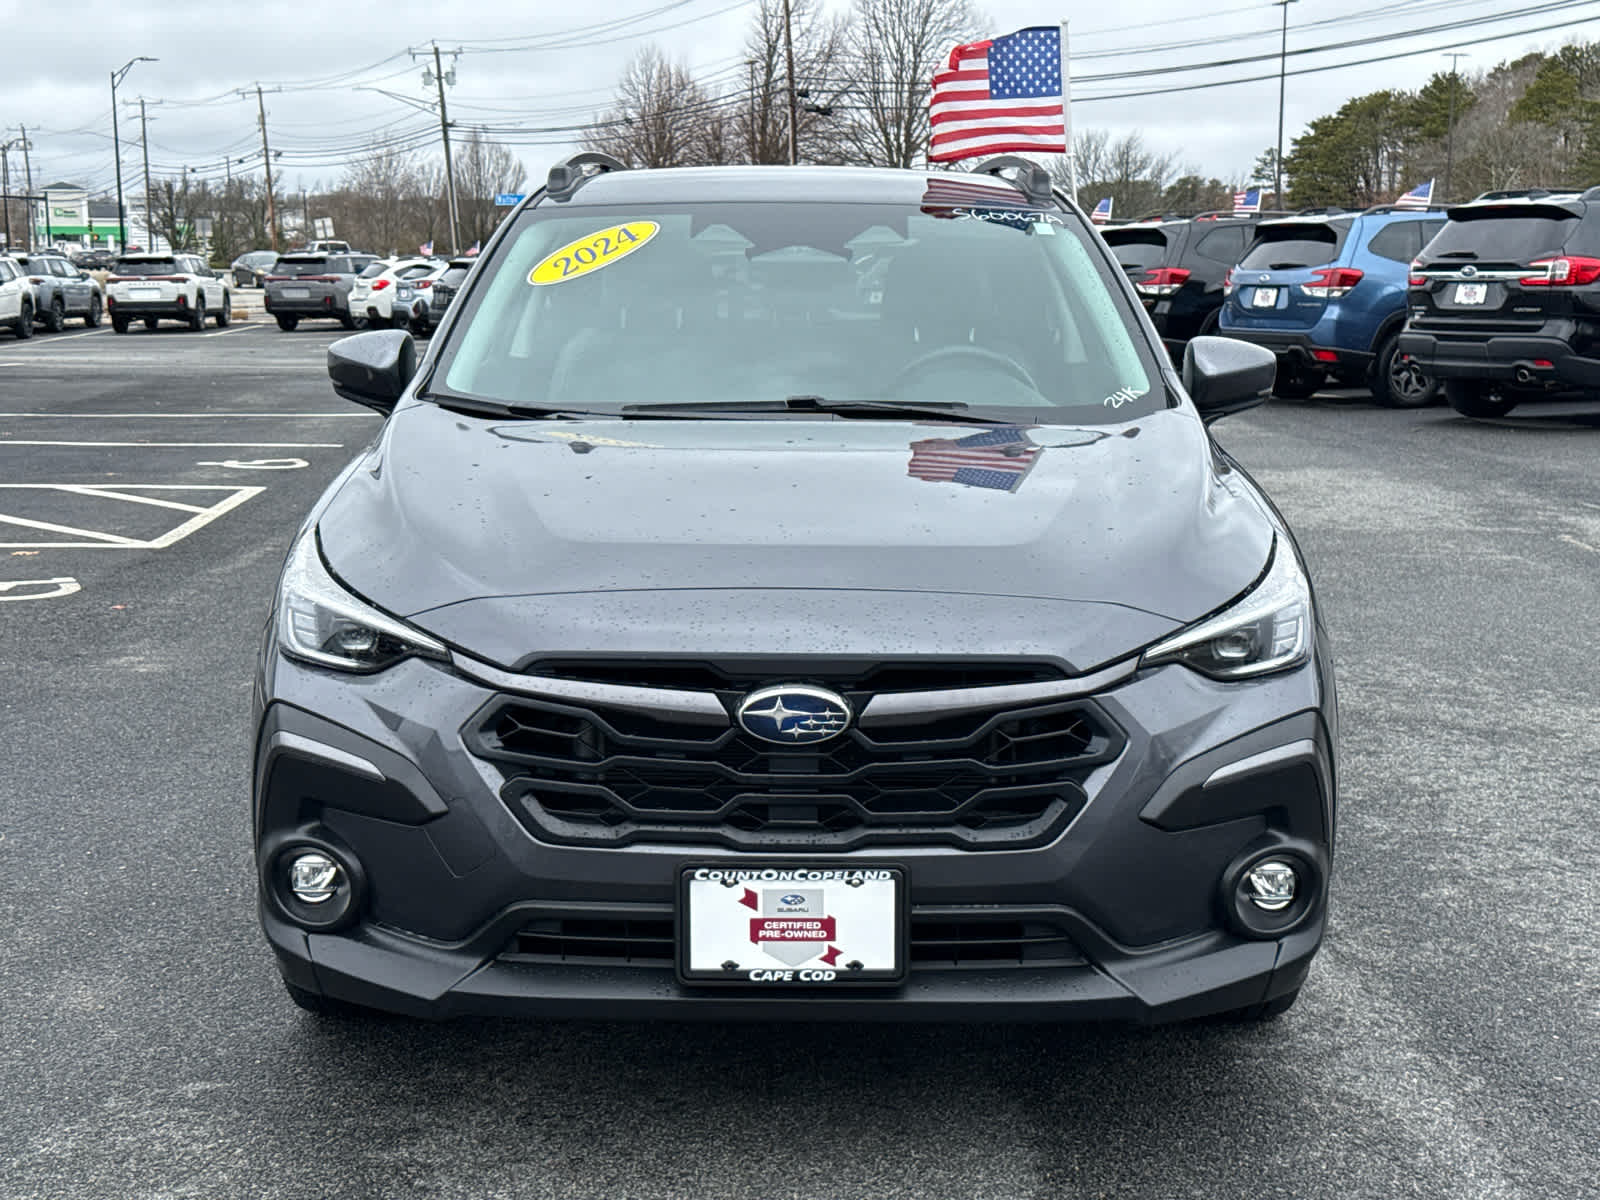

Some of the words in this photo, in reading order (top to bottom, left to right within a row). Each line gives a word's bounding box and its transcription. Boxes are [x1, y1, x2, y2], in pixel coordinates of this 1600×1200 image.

[552, 227, 640, 277] 2024
[1103, 386, 1145, 409] 24K
[763, 921, 822, 930] CERTIFIED
[758, 930, 828, 939] PRE-OWNED
[749, 968, 795, 981] CAPE
[799, 968, 837, 981] COD
